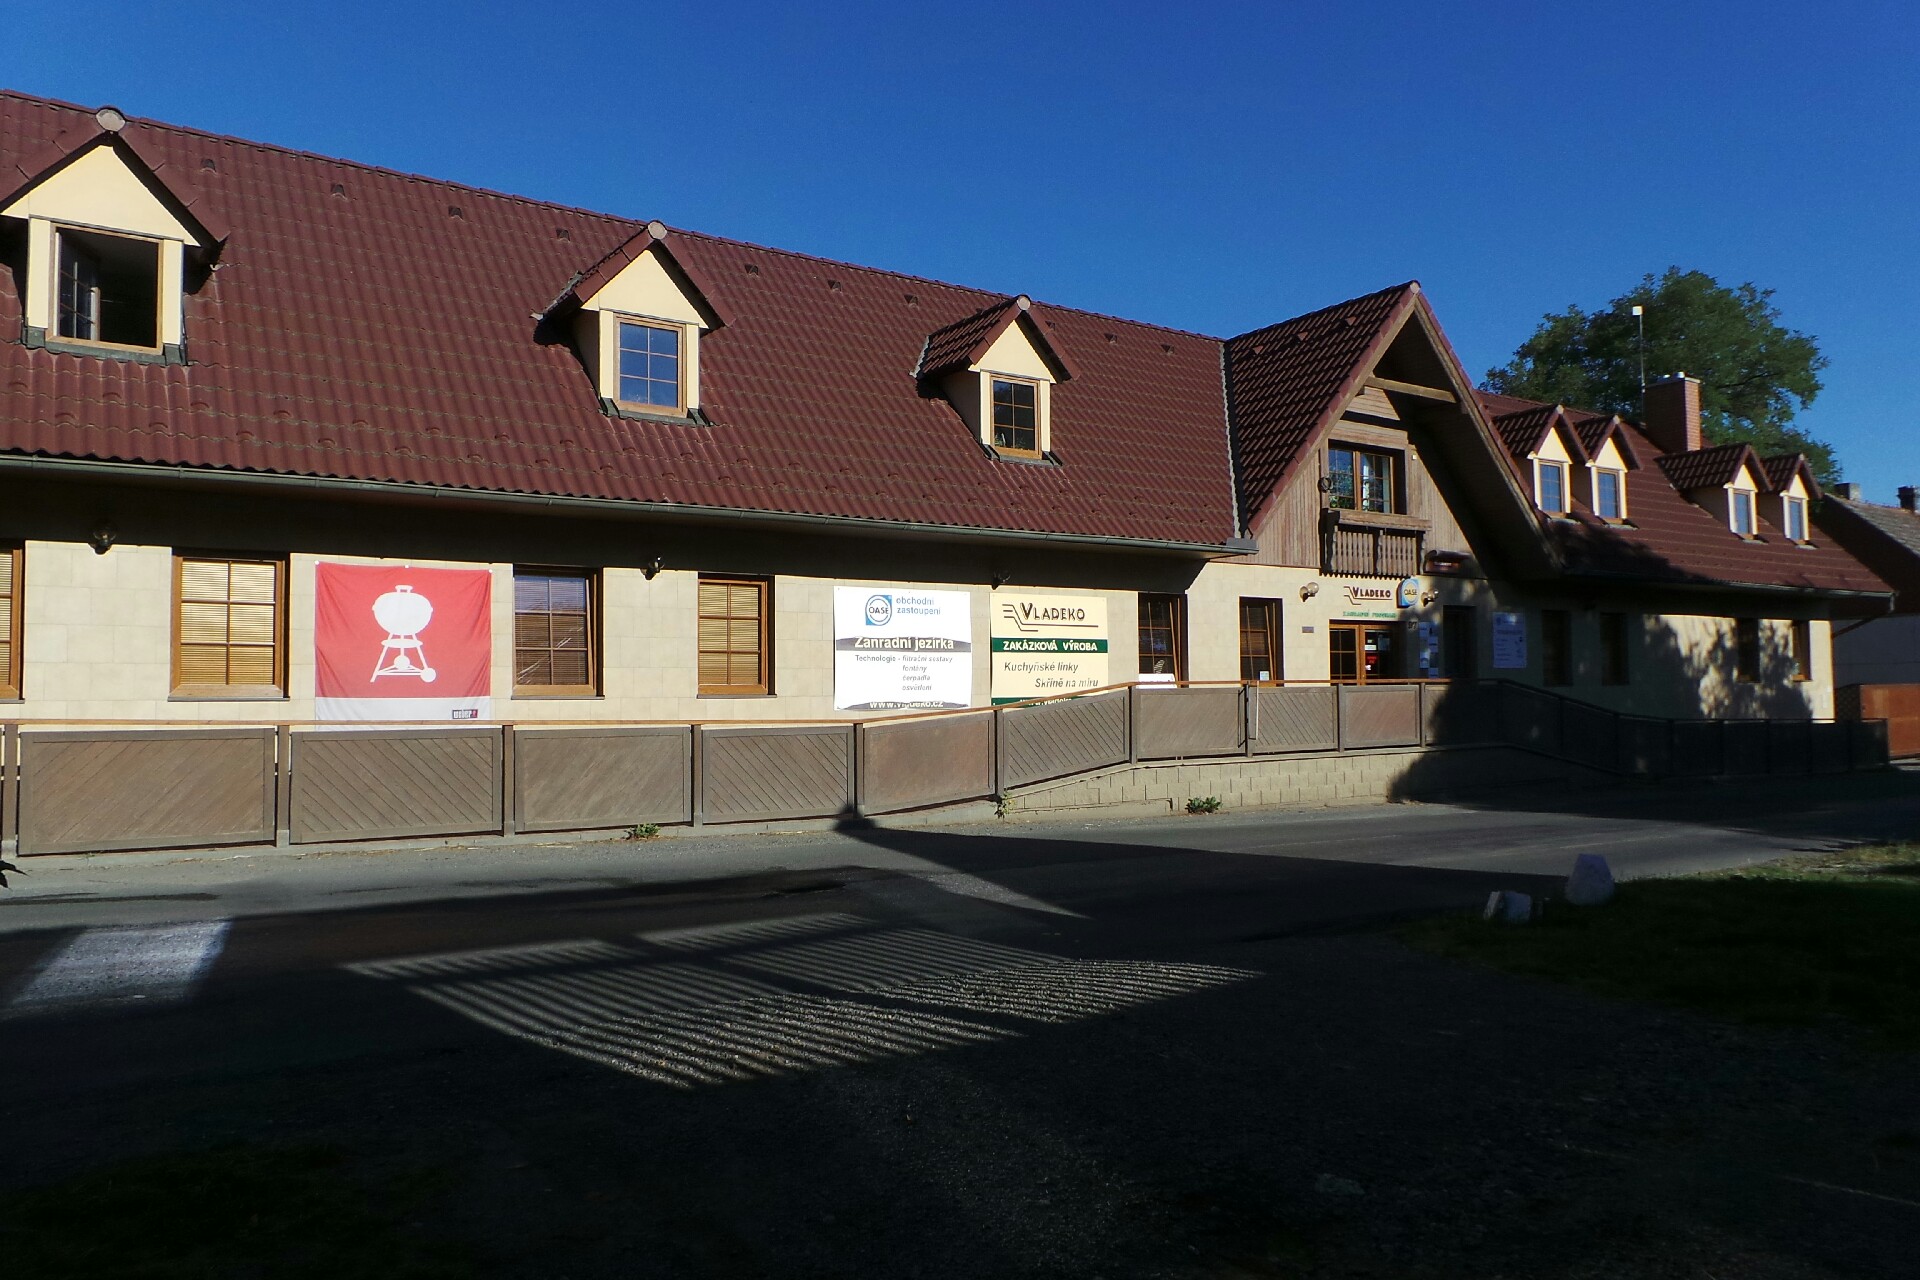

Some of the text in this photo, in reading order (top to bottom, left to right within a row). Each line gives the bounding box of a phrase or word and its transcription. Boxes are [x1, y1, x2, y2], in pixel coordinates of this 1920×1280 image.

[1353, 587, 1391, 598] VLADEKO
[868, 606, 889, 614] OASE
[1020, 602, 1085, 621] VLADEKO
[914, 637, 954, 651] jezírka
[1003, 639, 1098, 651] ZAKÁZKOVÁ VÝROBA
[855, 654, 896, 663] Technologie
[1004, 661, 1079, 674] Kuchyňské linky
[1035, 677, 1063, 688] Skříně
